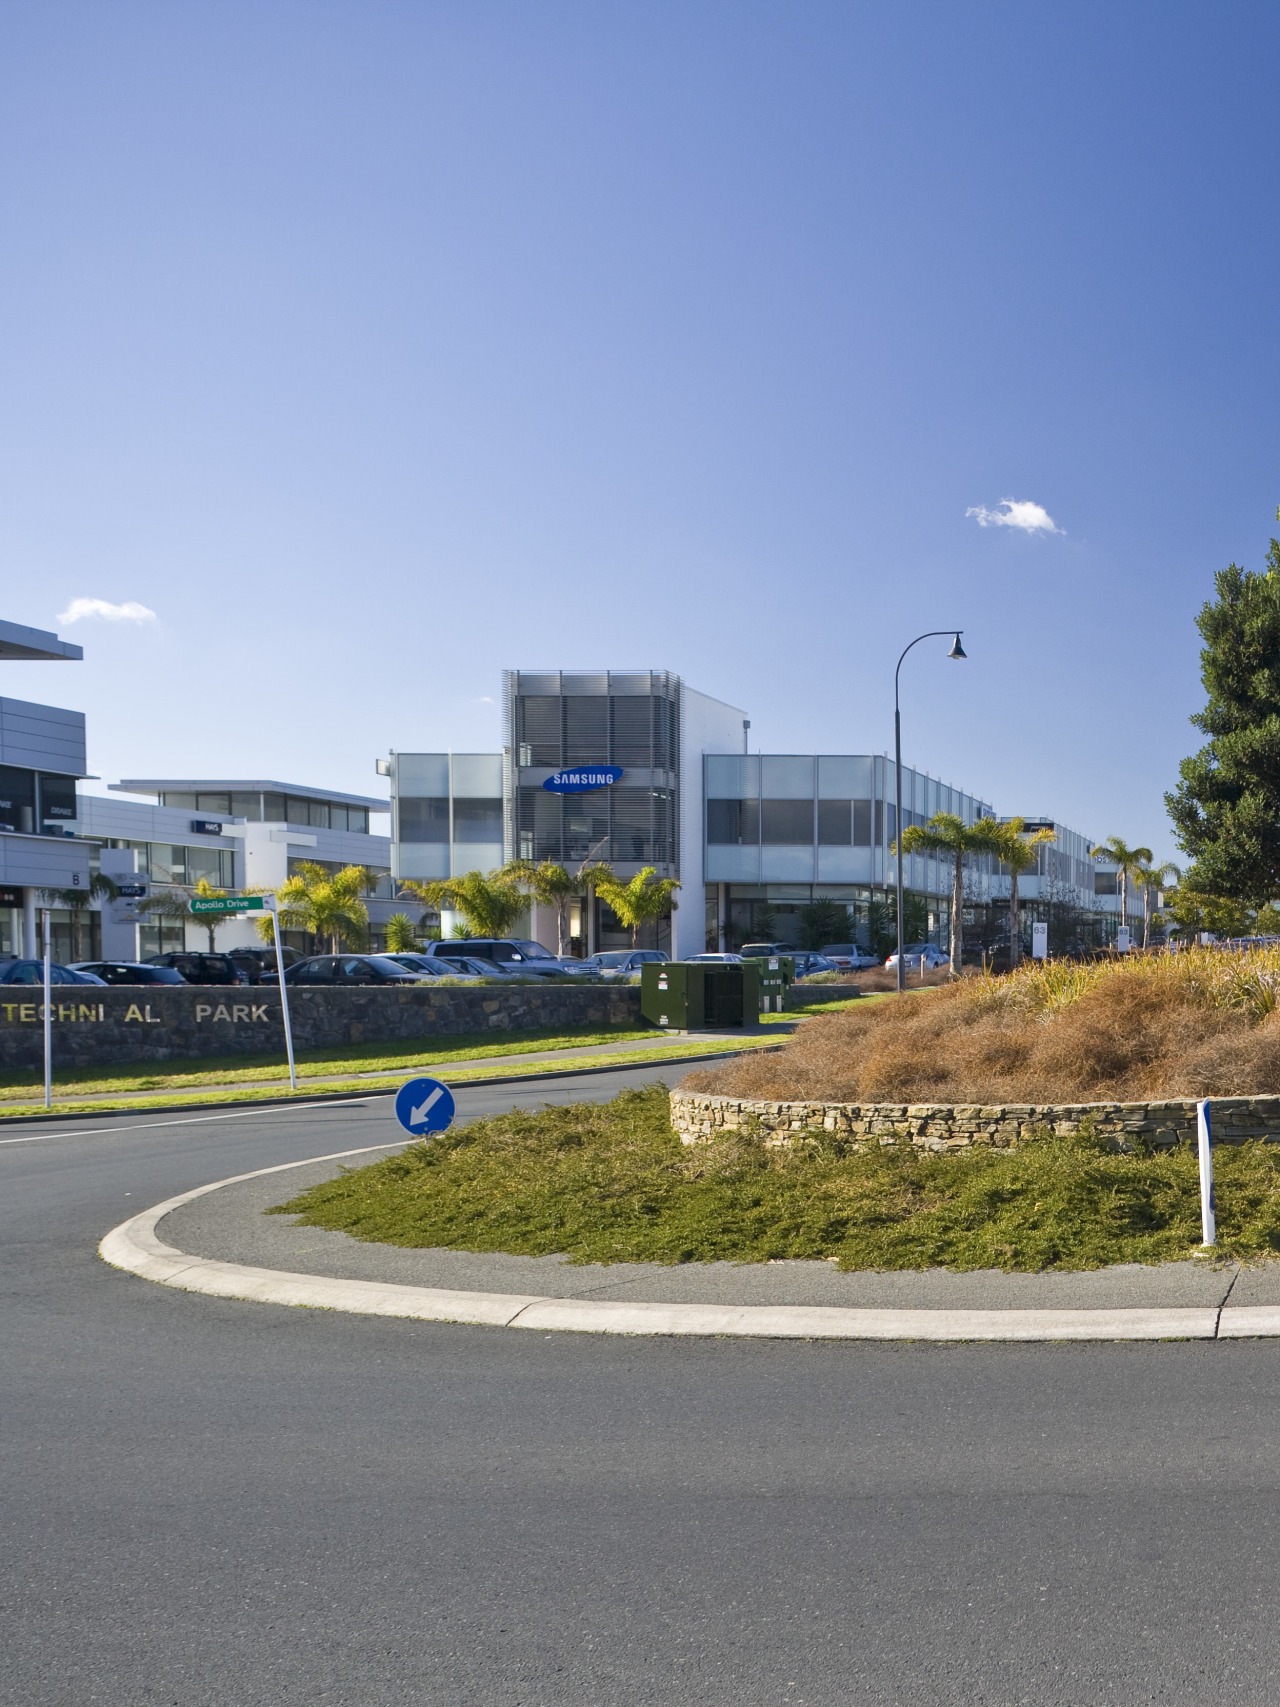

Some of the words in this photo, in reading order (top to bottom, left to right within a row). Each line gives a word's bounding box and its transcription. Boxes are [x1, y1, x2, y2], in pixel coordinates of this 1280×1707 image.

[553, 774, 614, 784] SAMSUNG
[205, 823, 219, 831] HAYS
[73, 874, 79, 885] B
[195, 901, 224, 910] Apollo
[1033, 926, 1046, 934] 63
[195, 1004, 270, 1023] PARK
